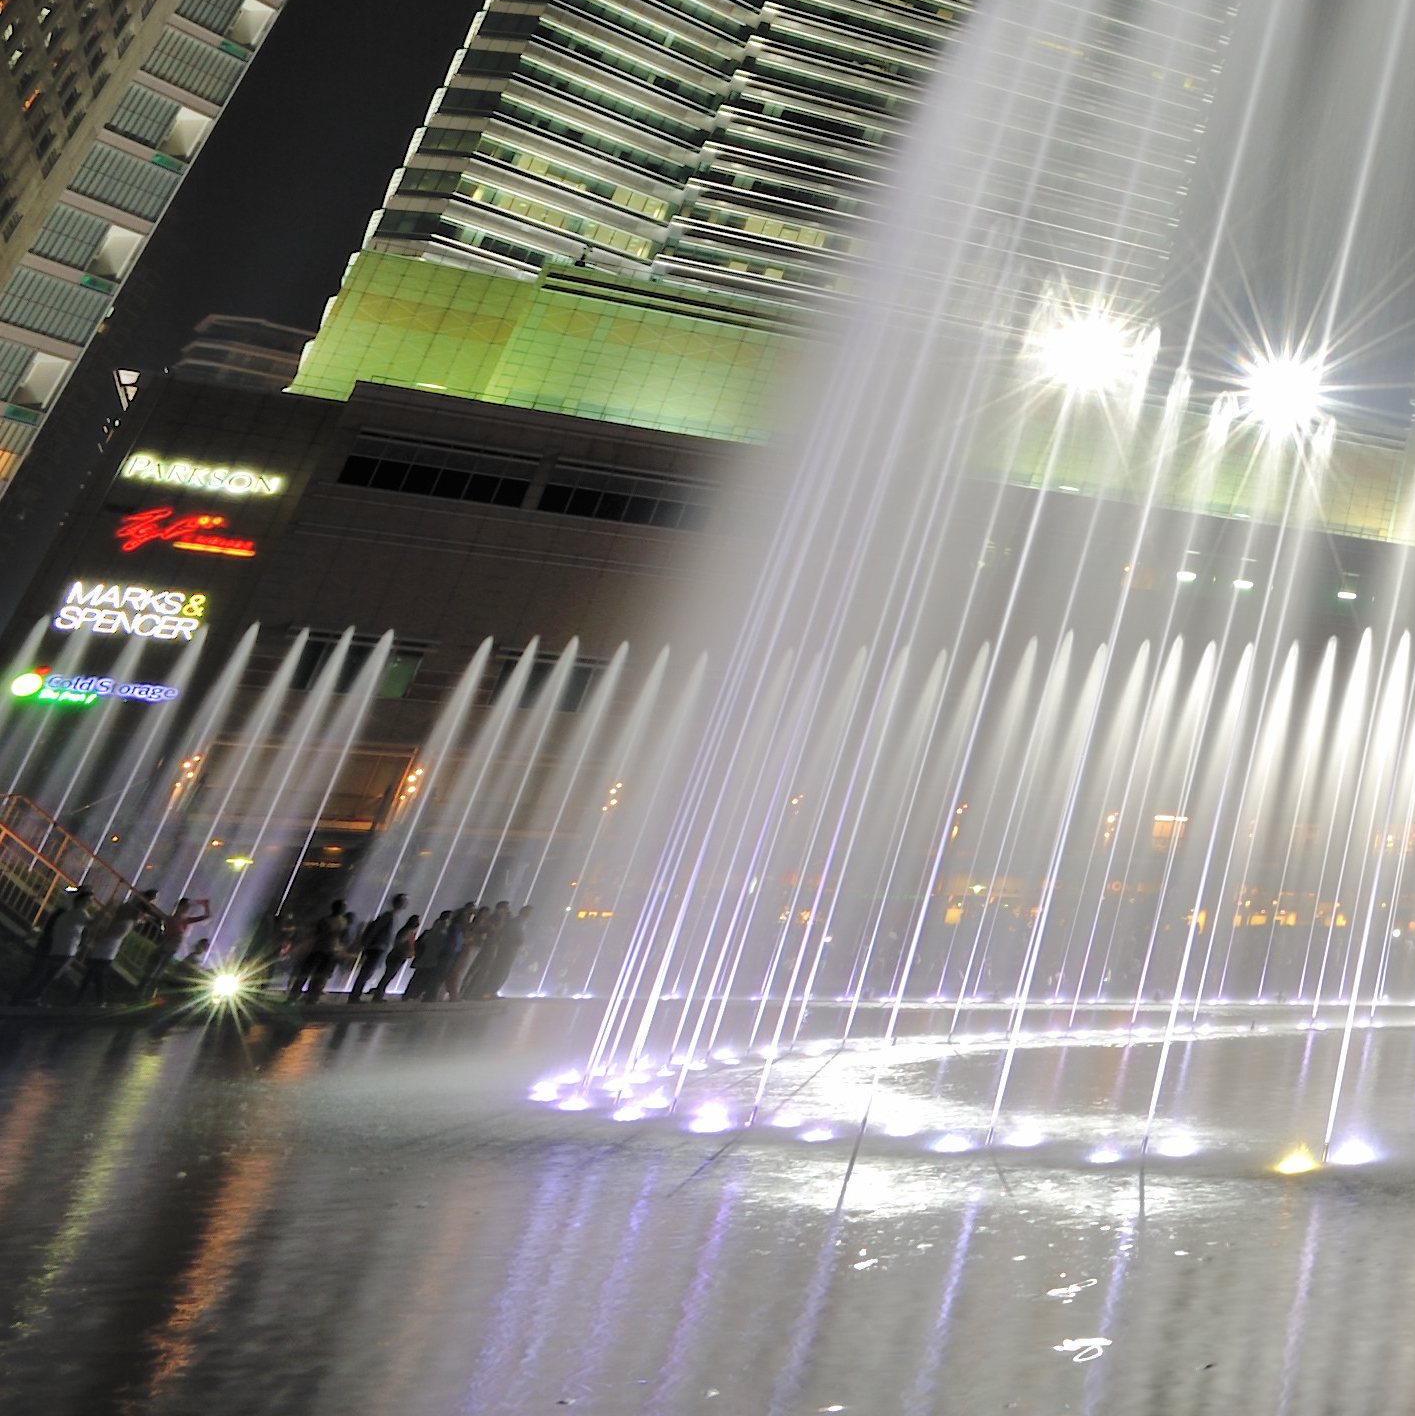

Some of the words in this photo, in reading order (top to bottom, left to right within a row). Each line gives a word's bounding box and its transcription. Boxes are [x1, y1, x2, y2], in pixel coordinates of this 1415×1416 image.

[121, 452, 284, 495] PARKSON
[66, 581, 186, 615] MARKS
[182, 594, 207, 617] &
[55, 605, 199, 640] SPENCER
[97, 677, 179, 702] Sorage
